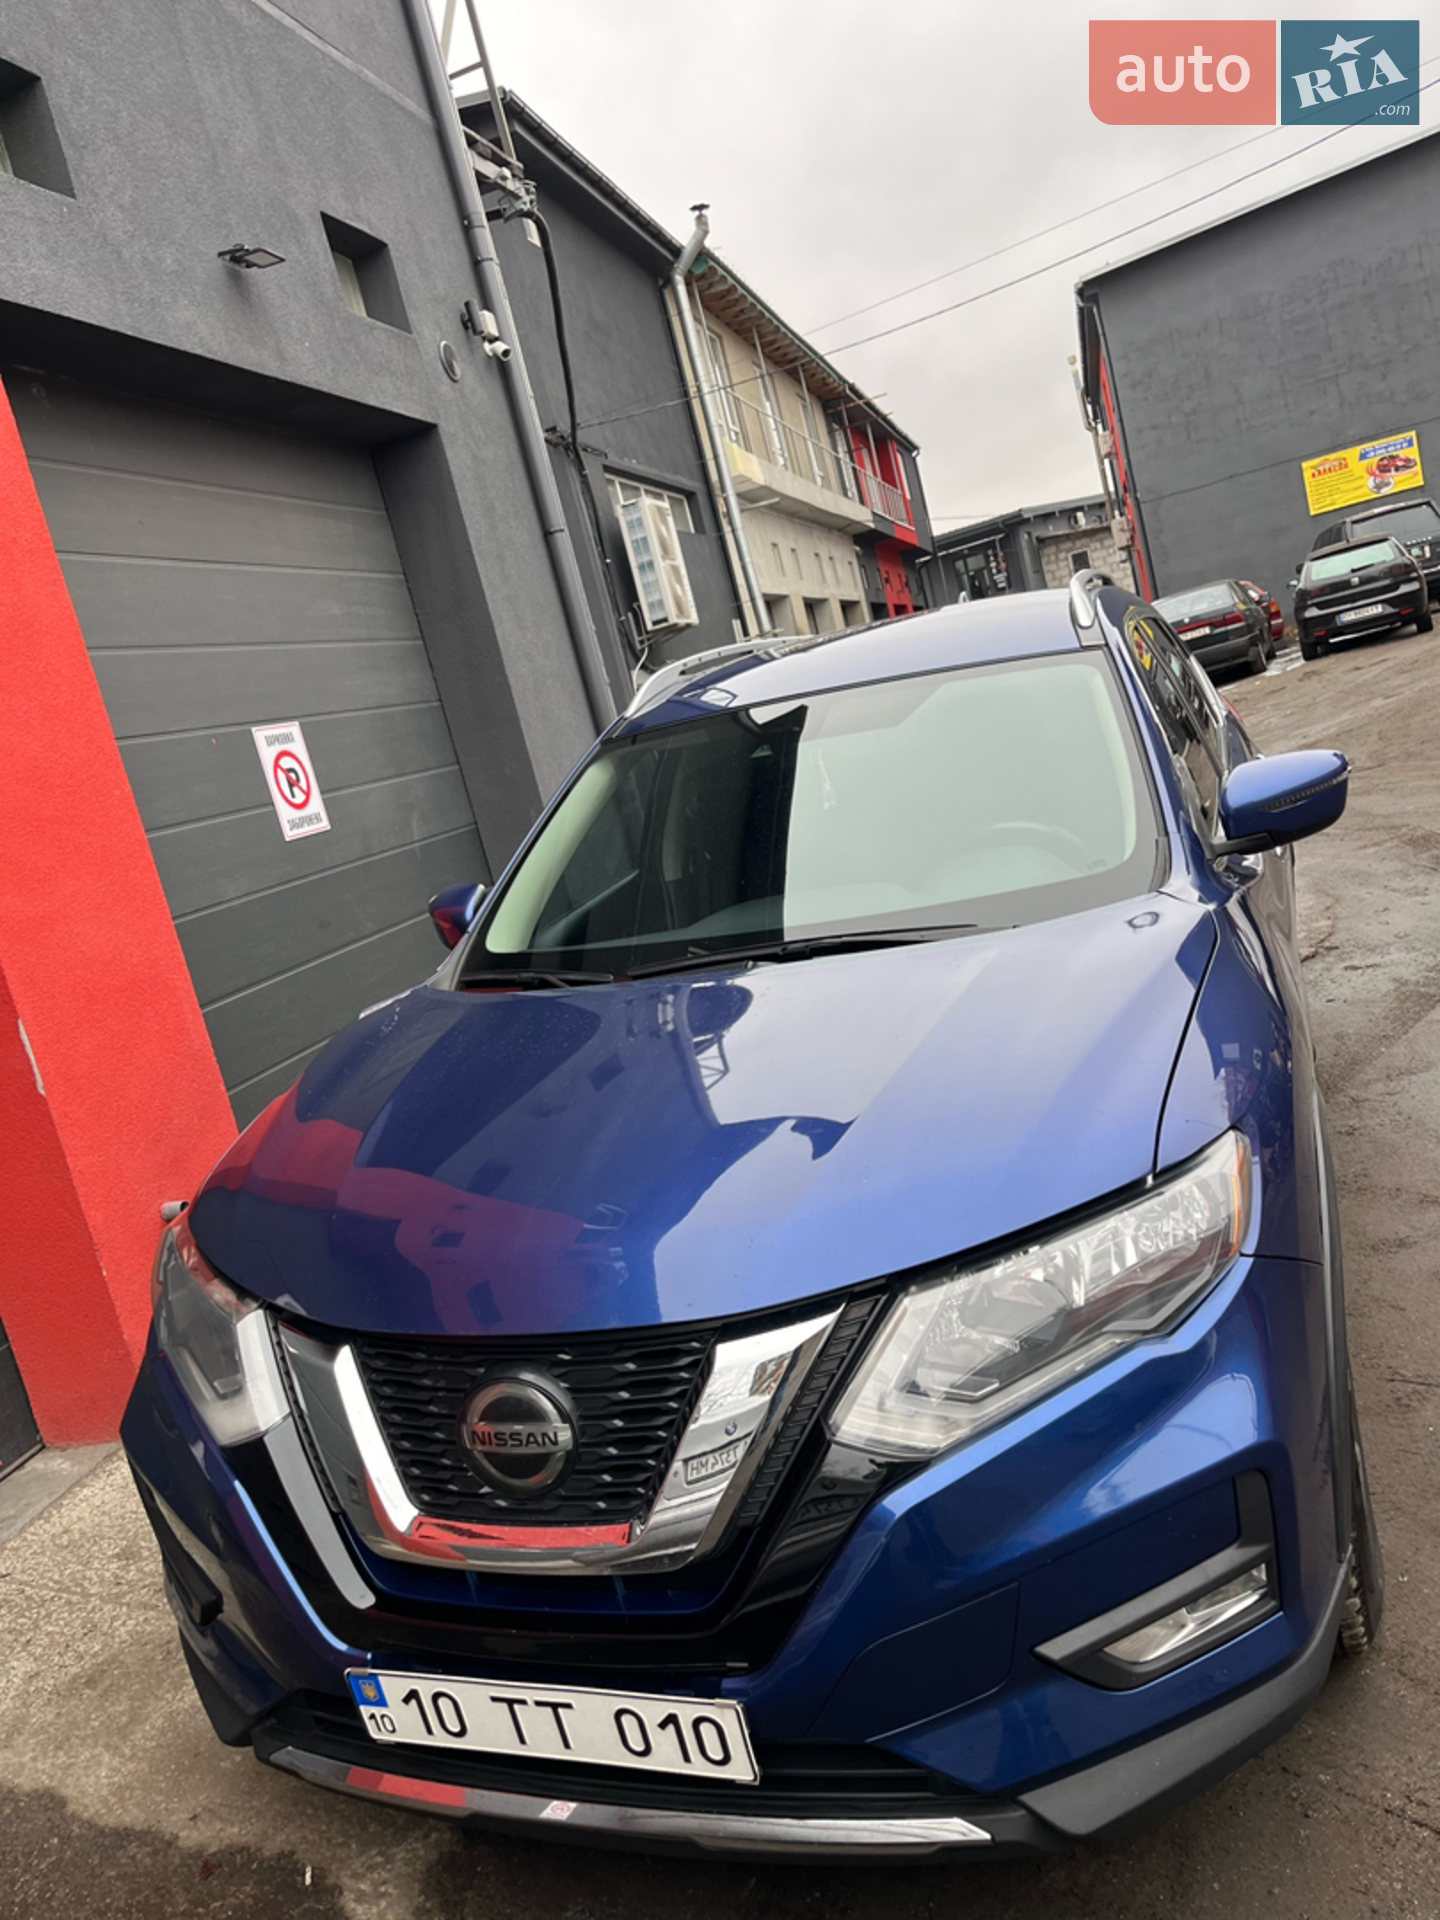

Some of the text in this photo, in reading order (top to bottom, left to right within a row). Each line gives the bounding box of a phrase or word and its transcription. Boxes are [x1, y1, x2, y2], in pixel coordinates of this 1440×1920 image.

[471, 1431, 559, 1447] NISSAN
[368, 1711, 396, 1735] 10
[401, 1688, 732, 1767] 10 TT 010
